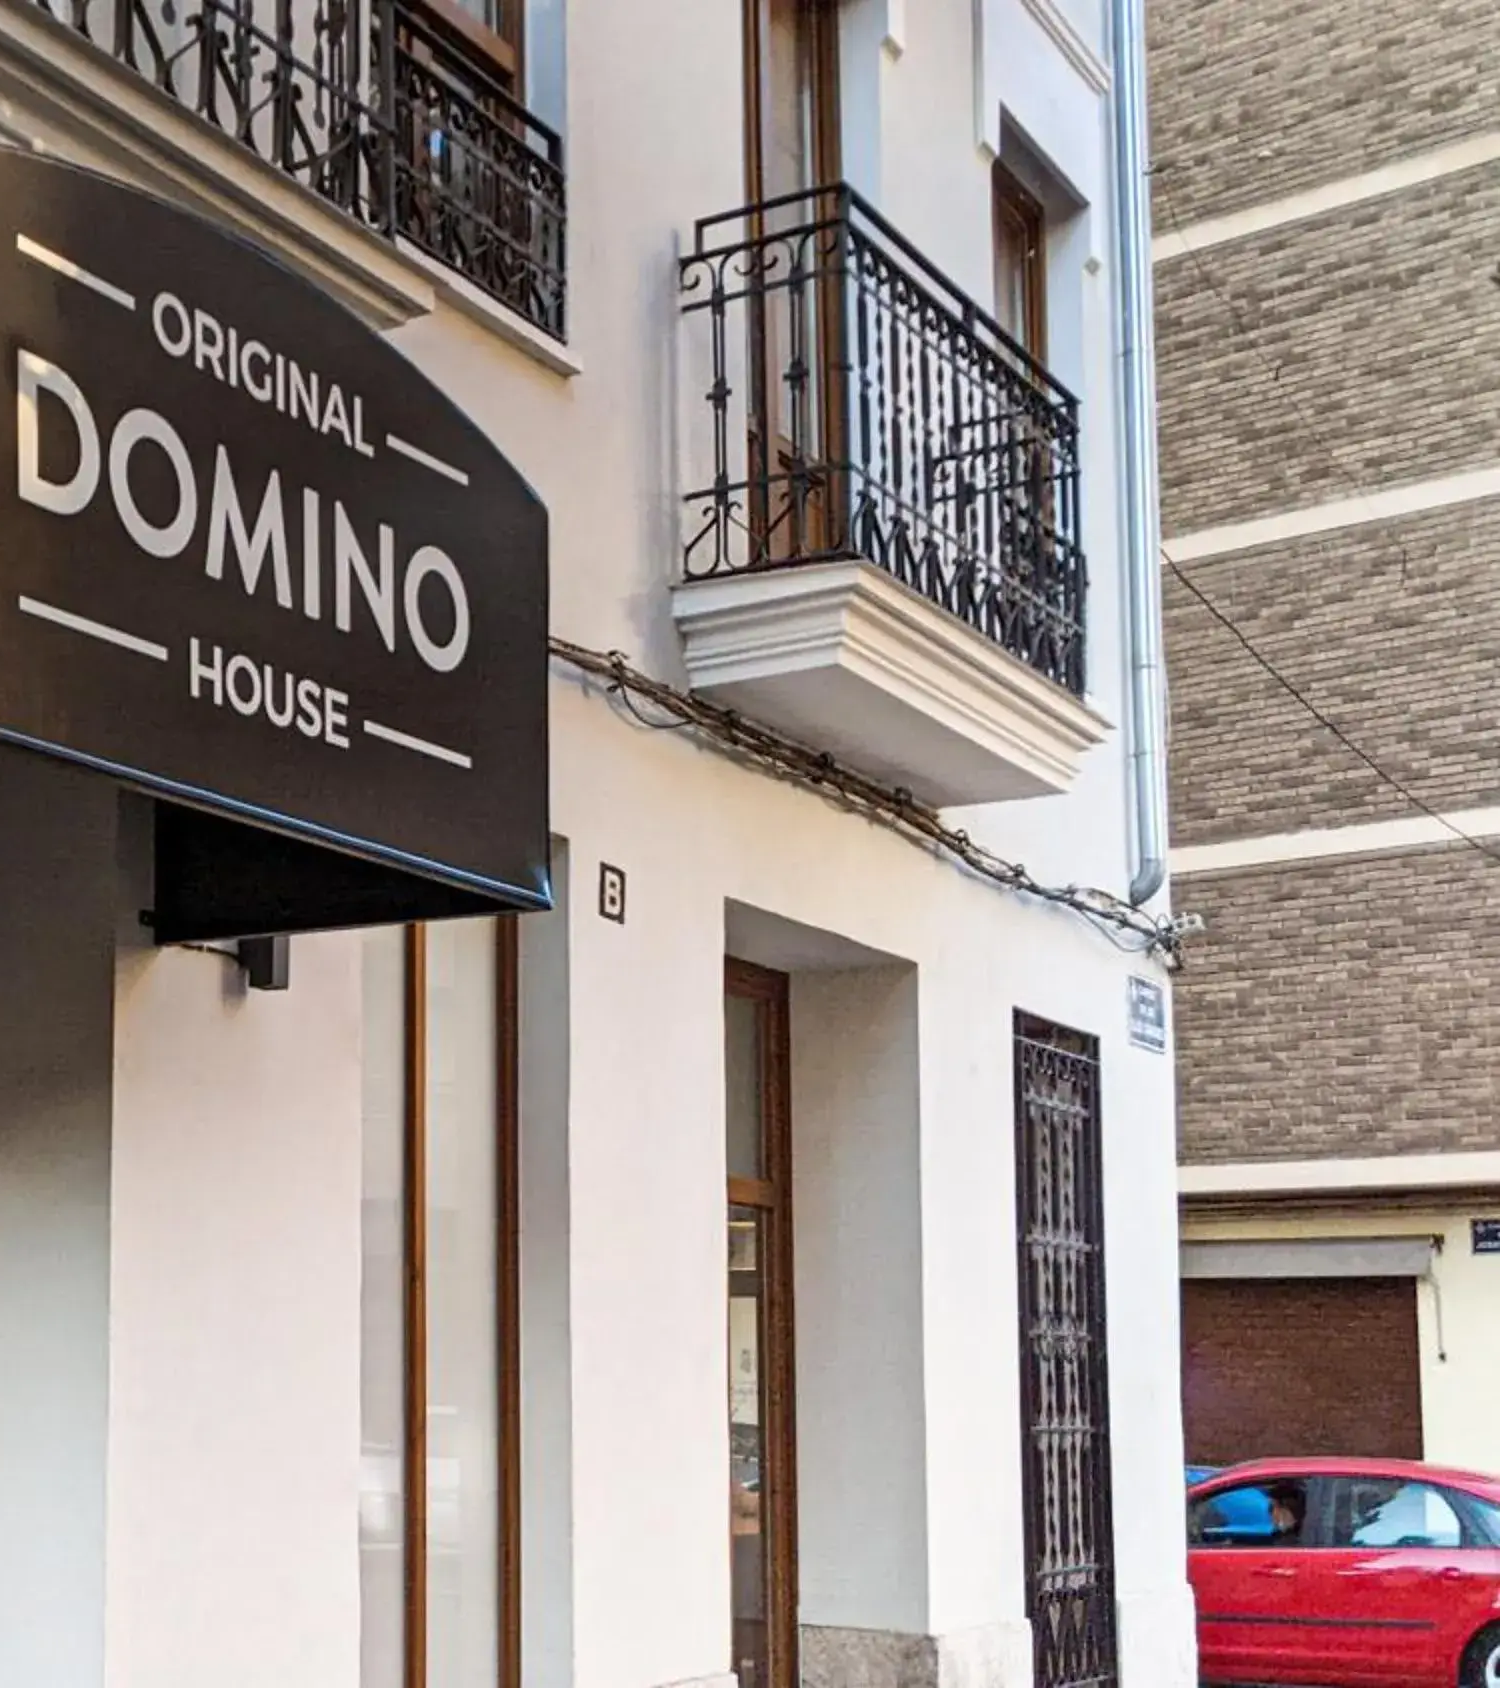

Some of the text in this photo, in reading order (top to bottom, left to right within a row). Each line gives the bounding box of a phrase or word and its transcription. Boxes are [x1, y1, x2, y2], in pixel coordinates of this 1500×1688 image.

[153, 291, 375, 458] ORIGINAL
[17, 348, 471, 673] DOMINO
[188, 636, 350, 749] HOUSE
